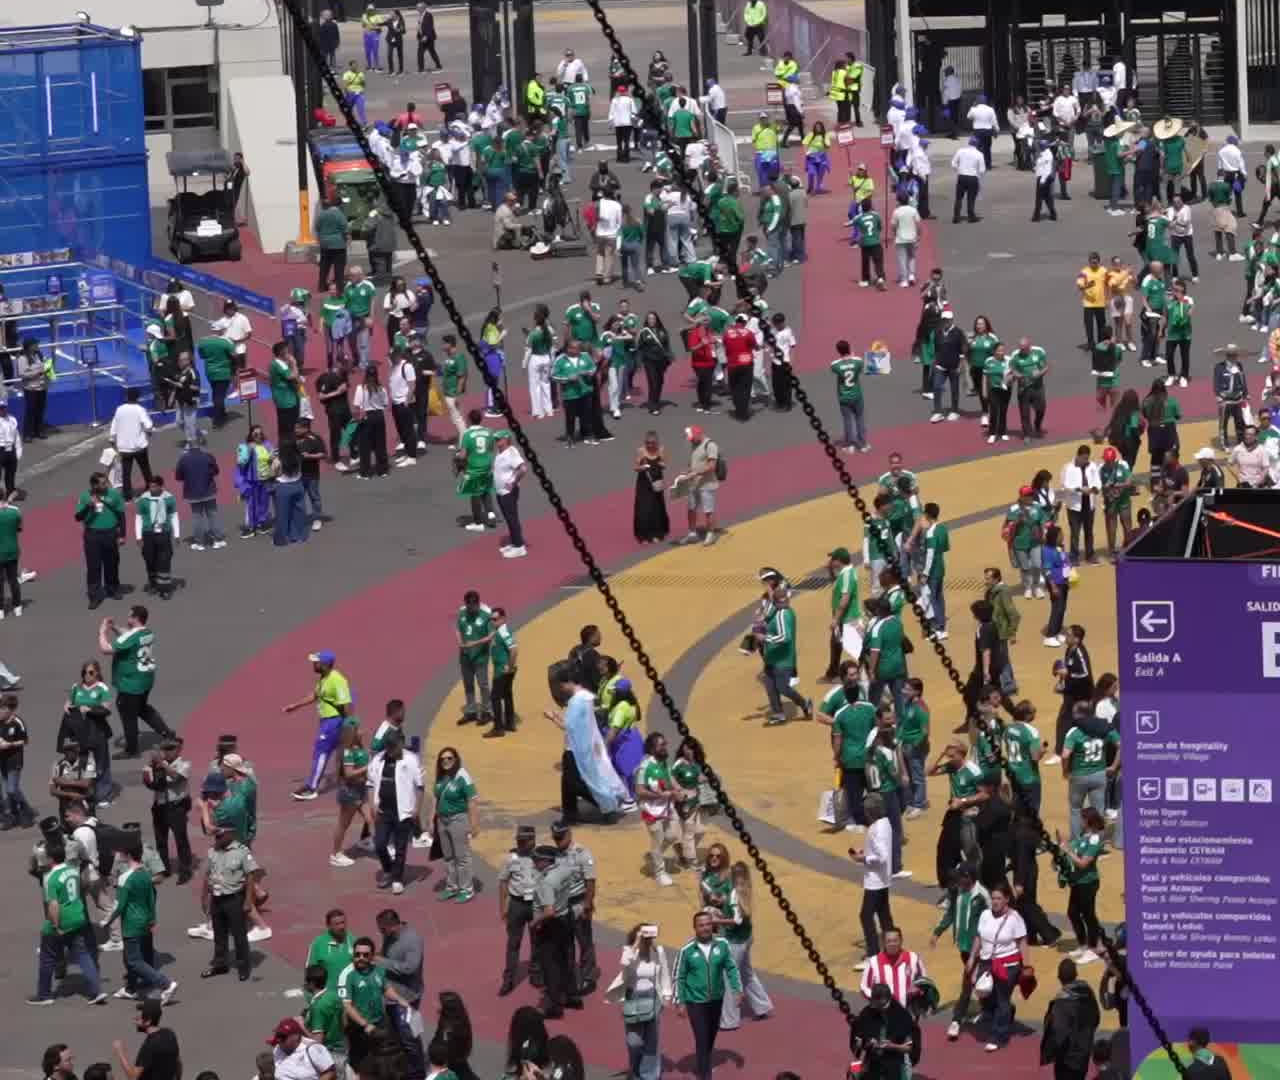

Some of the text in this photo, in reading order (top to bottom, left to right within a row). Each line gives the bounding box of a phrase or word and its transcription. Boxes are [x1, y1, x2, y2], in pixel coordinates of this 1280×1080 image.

[845, 371, 855, 386] 2
[475, 436, 486, 454] 9
[1134, 652, 1182, 663] Salida A
[1135, 667, 1165, 677] Exit A
